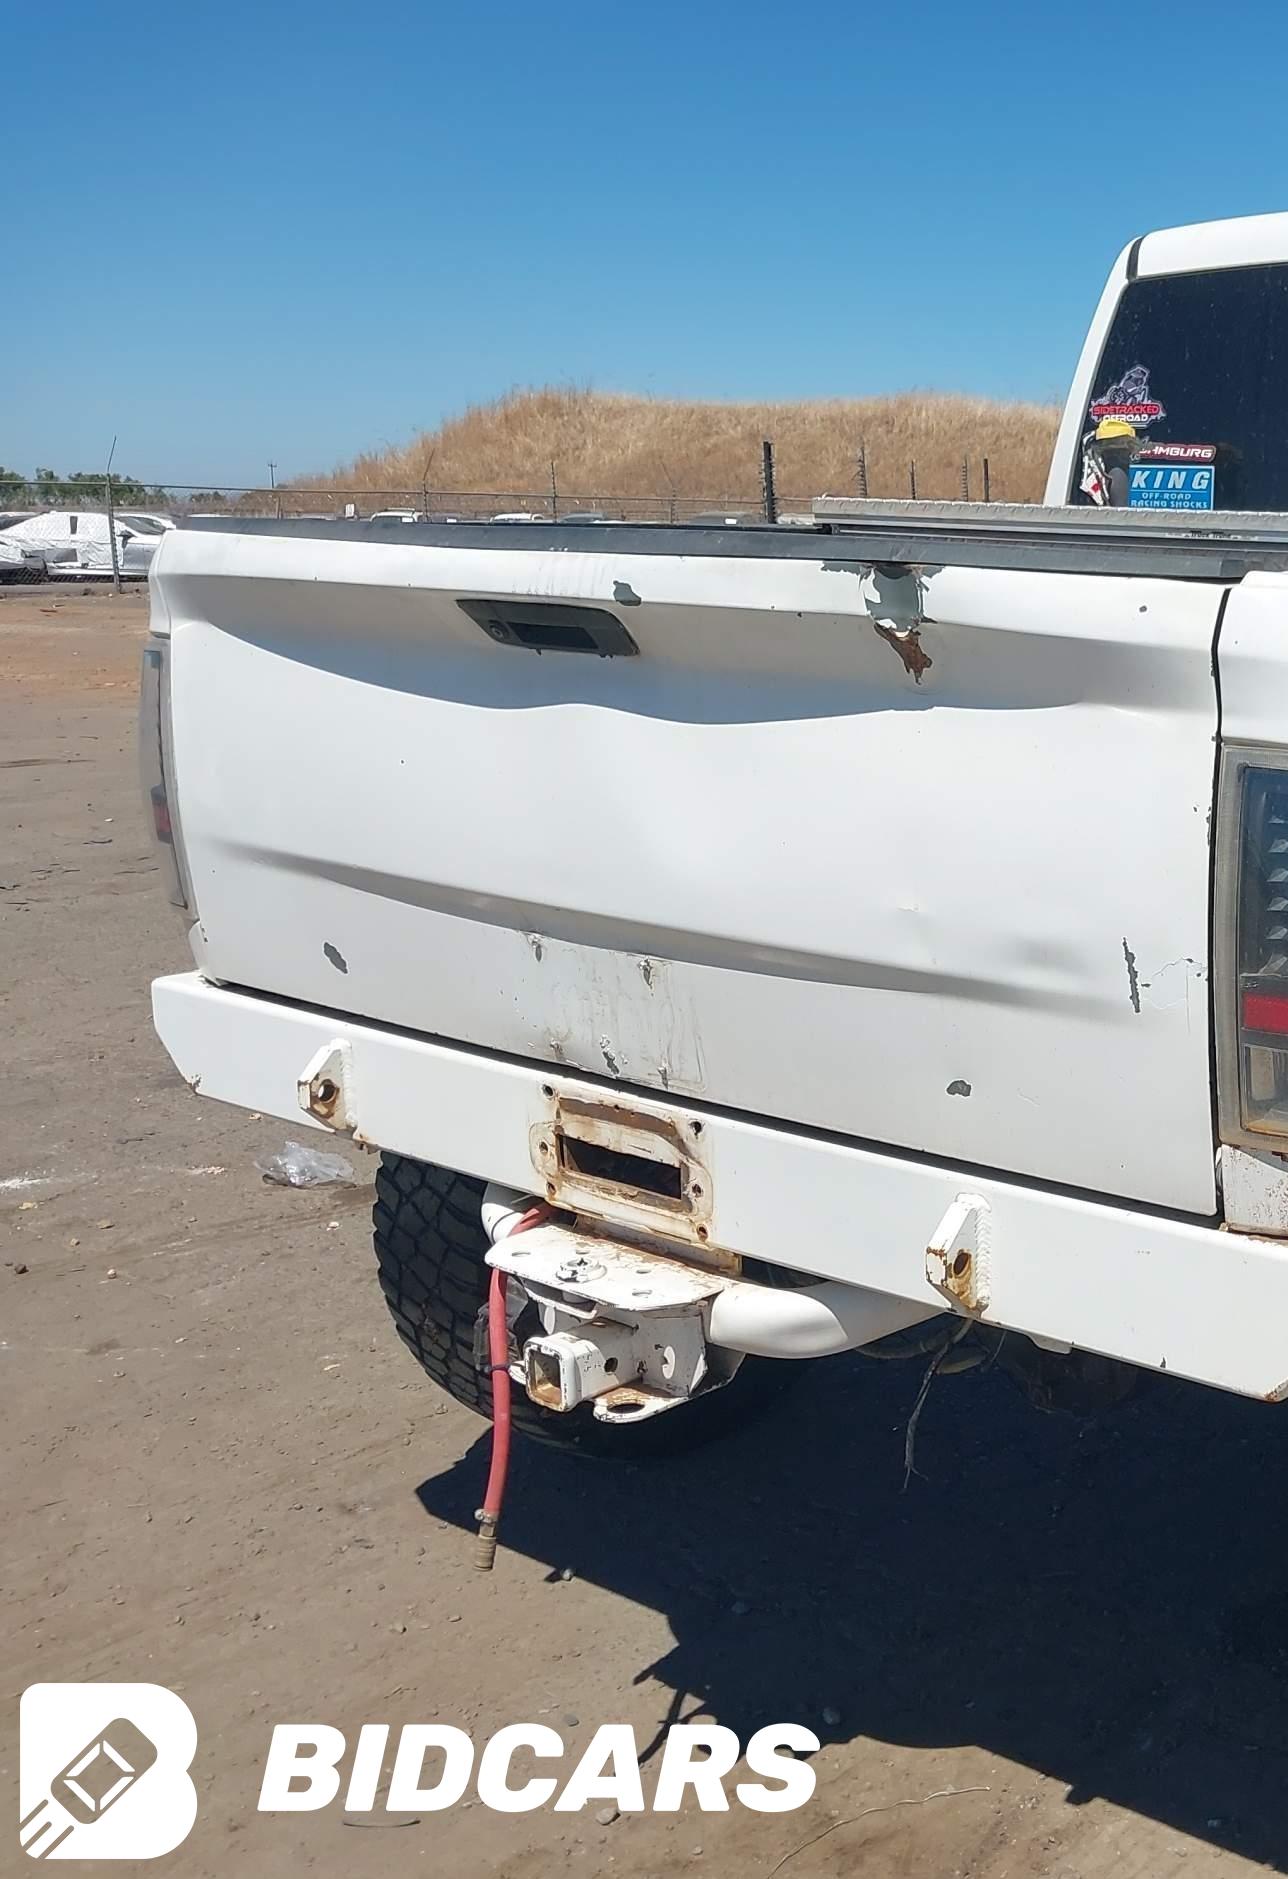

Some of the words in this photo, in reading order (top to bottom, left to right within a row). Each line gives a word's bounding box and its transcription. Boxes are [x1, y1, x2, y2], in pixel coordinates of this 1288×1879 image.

[1093, 405, 1159, 415] SIDETRACKED
[1102, 414, 1148, 422] OFFROAD
[1132, 471, 1210, 489] KING
[1131, 500, 1167, 508] RACING
[1170, 501, 1208, 509] SHOCKS
